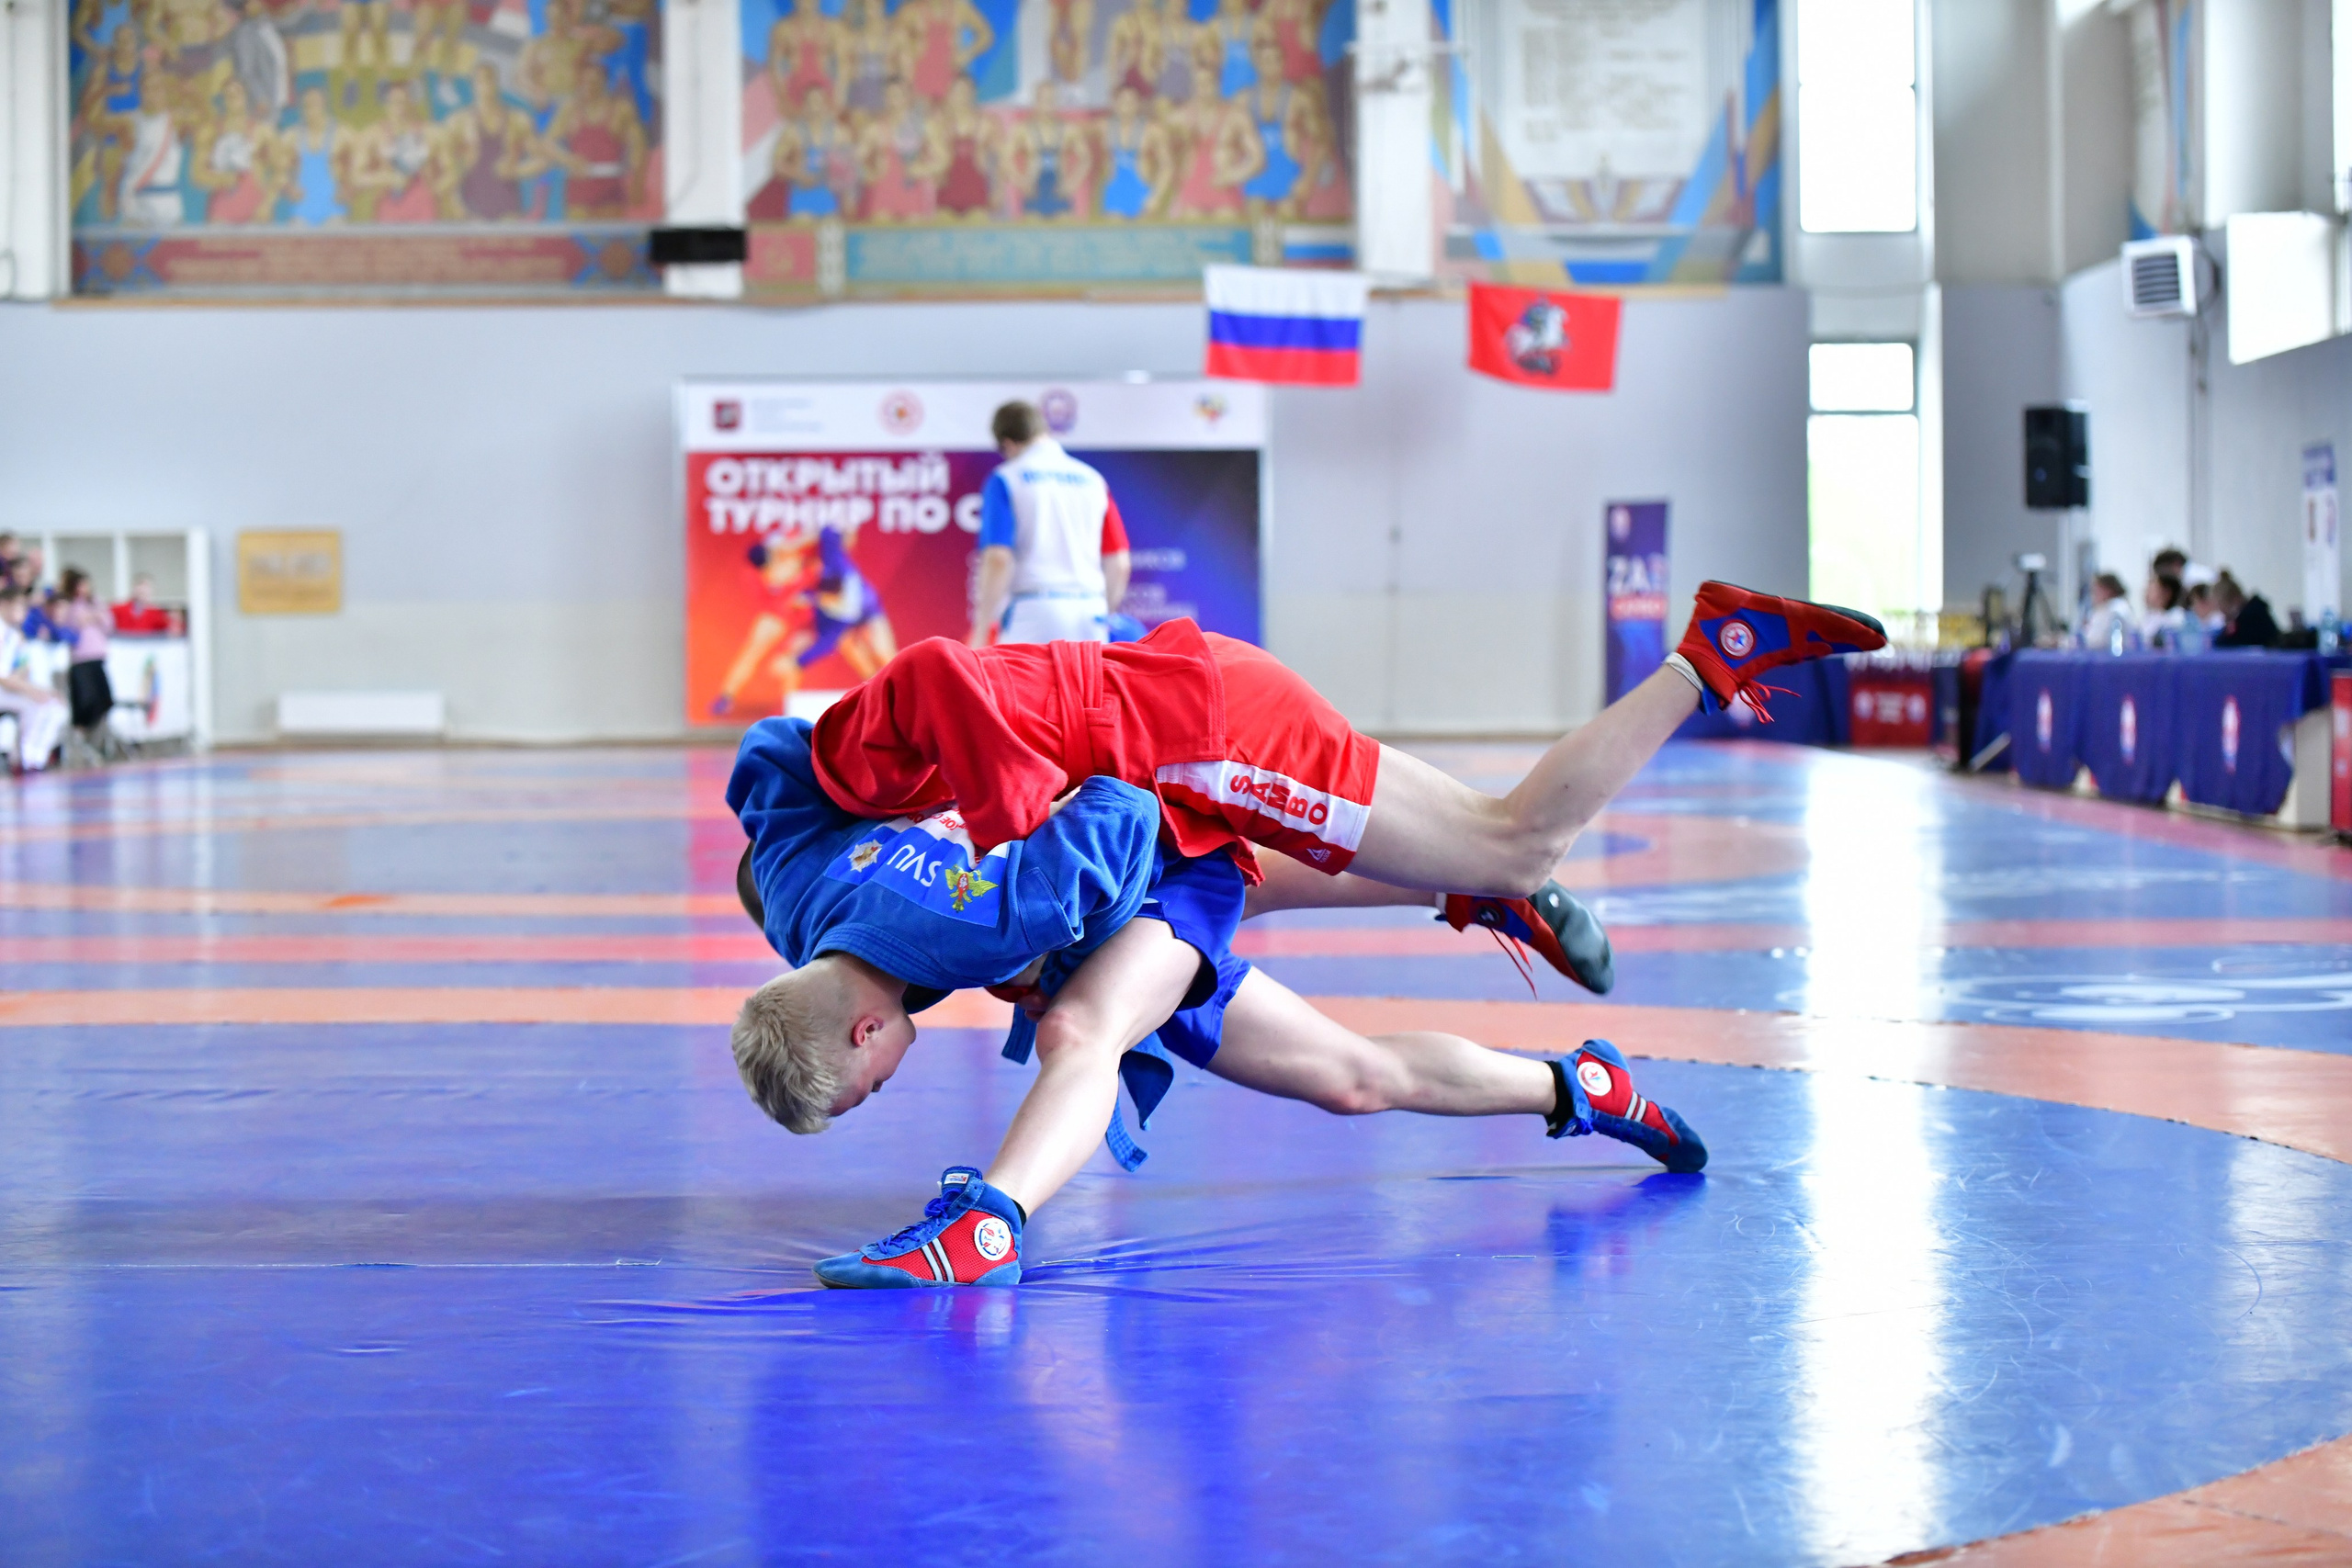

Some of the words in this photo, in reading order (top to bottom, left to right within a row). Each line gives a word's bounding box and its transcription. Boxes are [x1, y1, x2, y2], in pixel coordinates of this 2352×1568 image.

[705, 452, 949, 496] ОТКРЫТЫЙ
[707, 495, 873, 534] ТУРНИР
[877, 494, 951, 534] ПО
[1229, 774, 1328, 825] SAMBO
[886, 843, 943, 887] SVU
